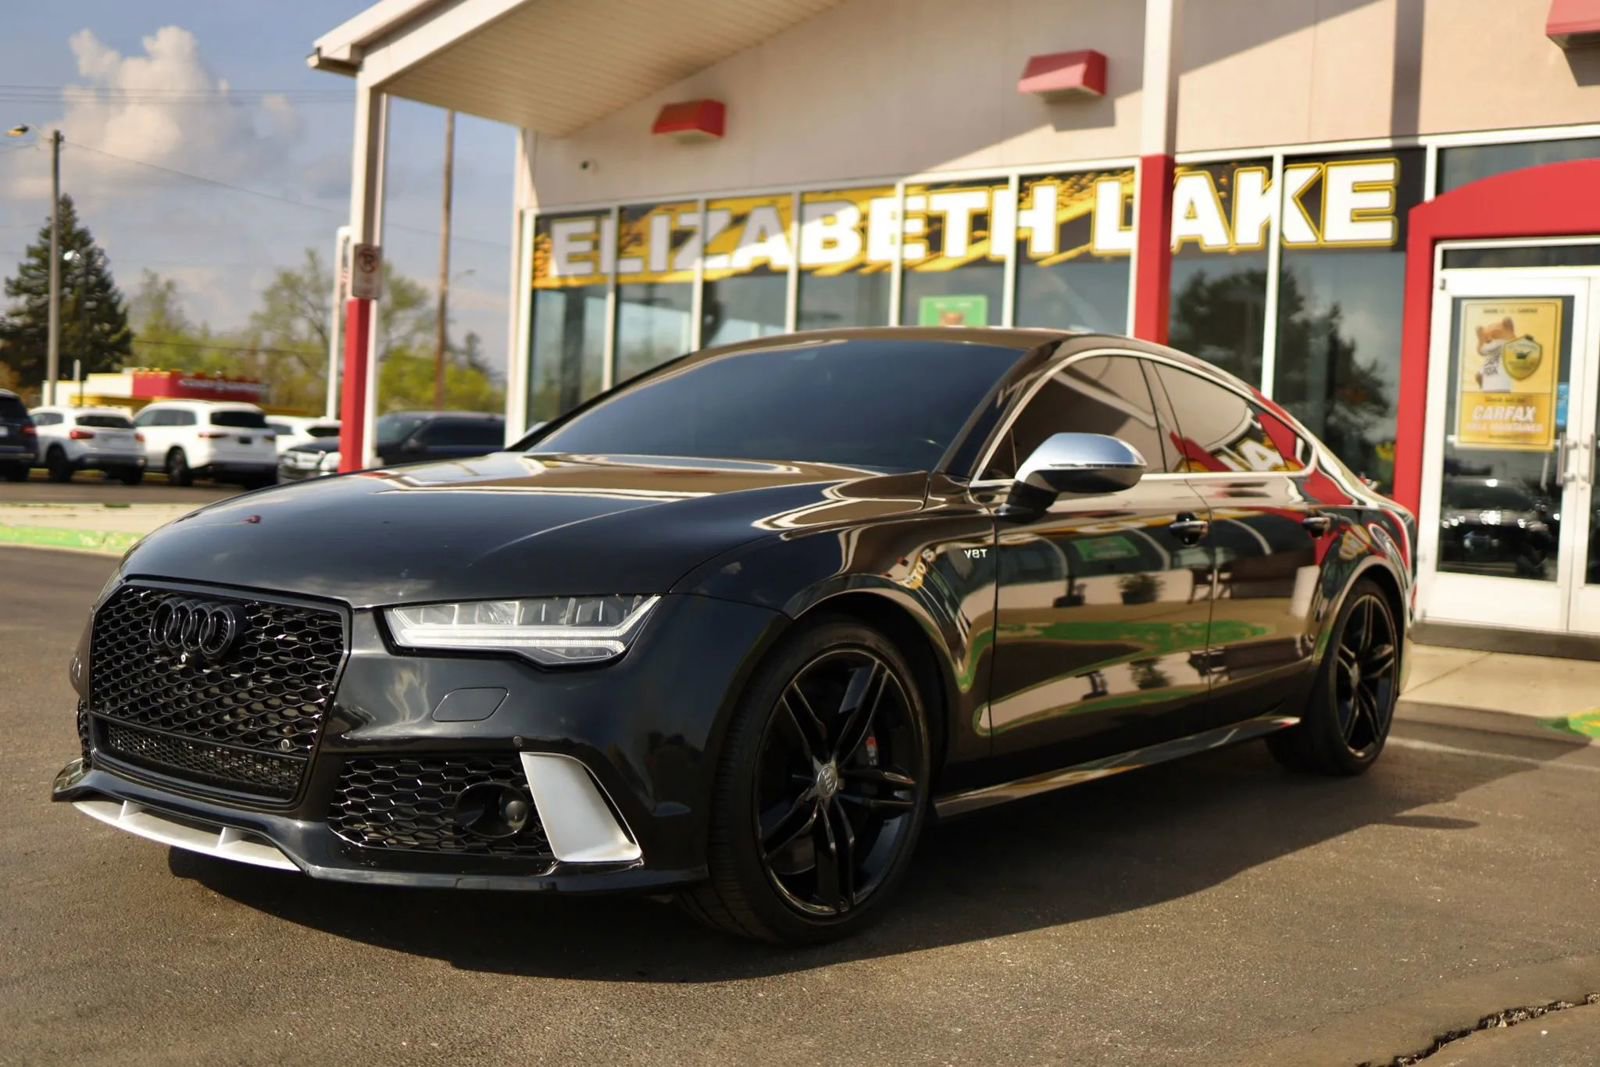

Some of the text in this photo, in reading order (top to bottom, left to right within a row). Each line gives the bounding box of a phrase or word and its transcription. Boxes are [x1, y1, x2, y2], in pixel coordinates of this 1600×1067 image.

[549, 159, 1399, 278] ELIZABETH LAKE
[1472, 405, 1536, 422] CARFAX
[963, 548, 988, 559] V8T
